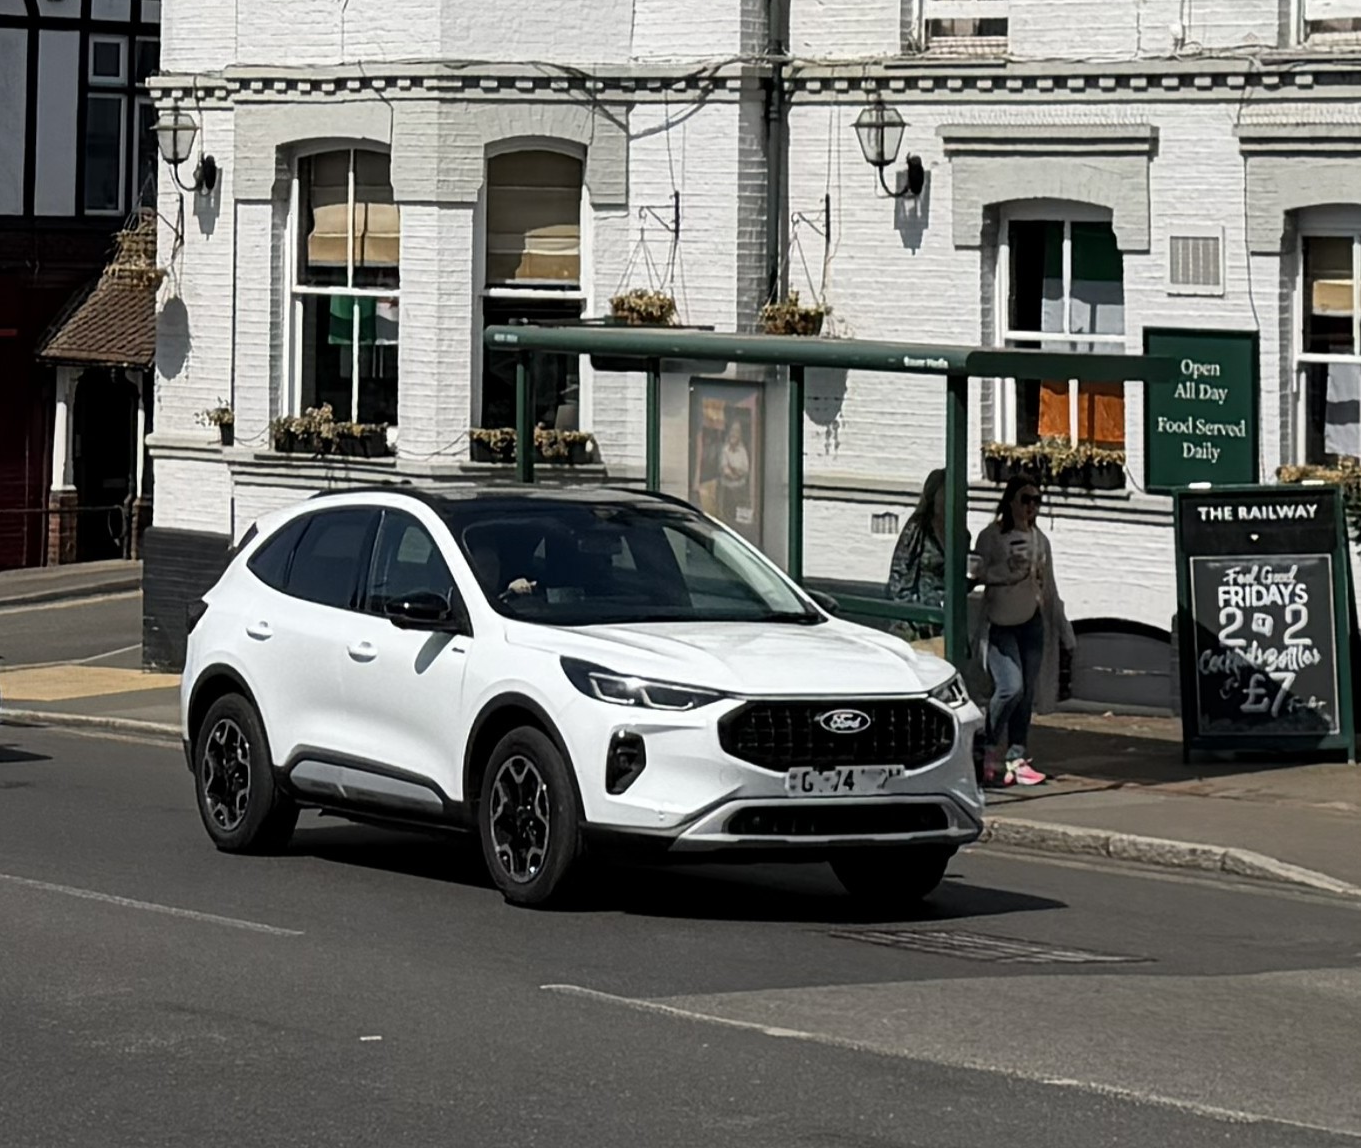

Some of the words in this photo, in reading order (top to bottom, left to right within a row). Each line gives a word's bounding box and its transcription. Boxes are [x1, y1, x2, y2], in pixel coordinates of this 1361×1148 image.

[1180, 359, 1221, 380] Open
[1174, 381, 1196, 399] All
[1199, 383, 1228, 405] Day
[1157, 416, 1193, 434] Food
[1196, 419, 1246, 437] Served
[1182, 442, 1221, 463] Daily
[1197, 506, 1234, 522] THE
[1237, 504, 1318, 521] RAILWAY
[1217, 583, 1309, 608] FRIDAYS
[1217, 606, 1248, 647] 2
[1282, 603, 1313, 646] 2
[1239, 671, 1297, 719] £7
[829, 712, 863, 730] Ford
